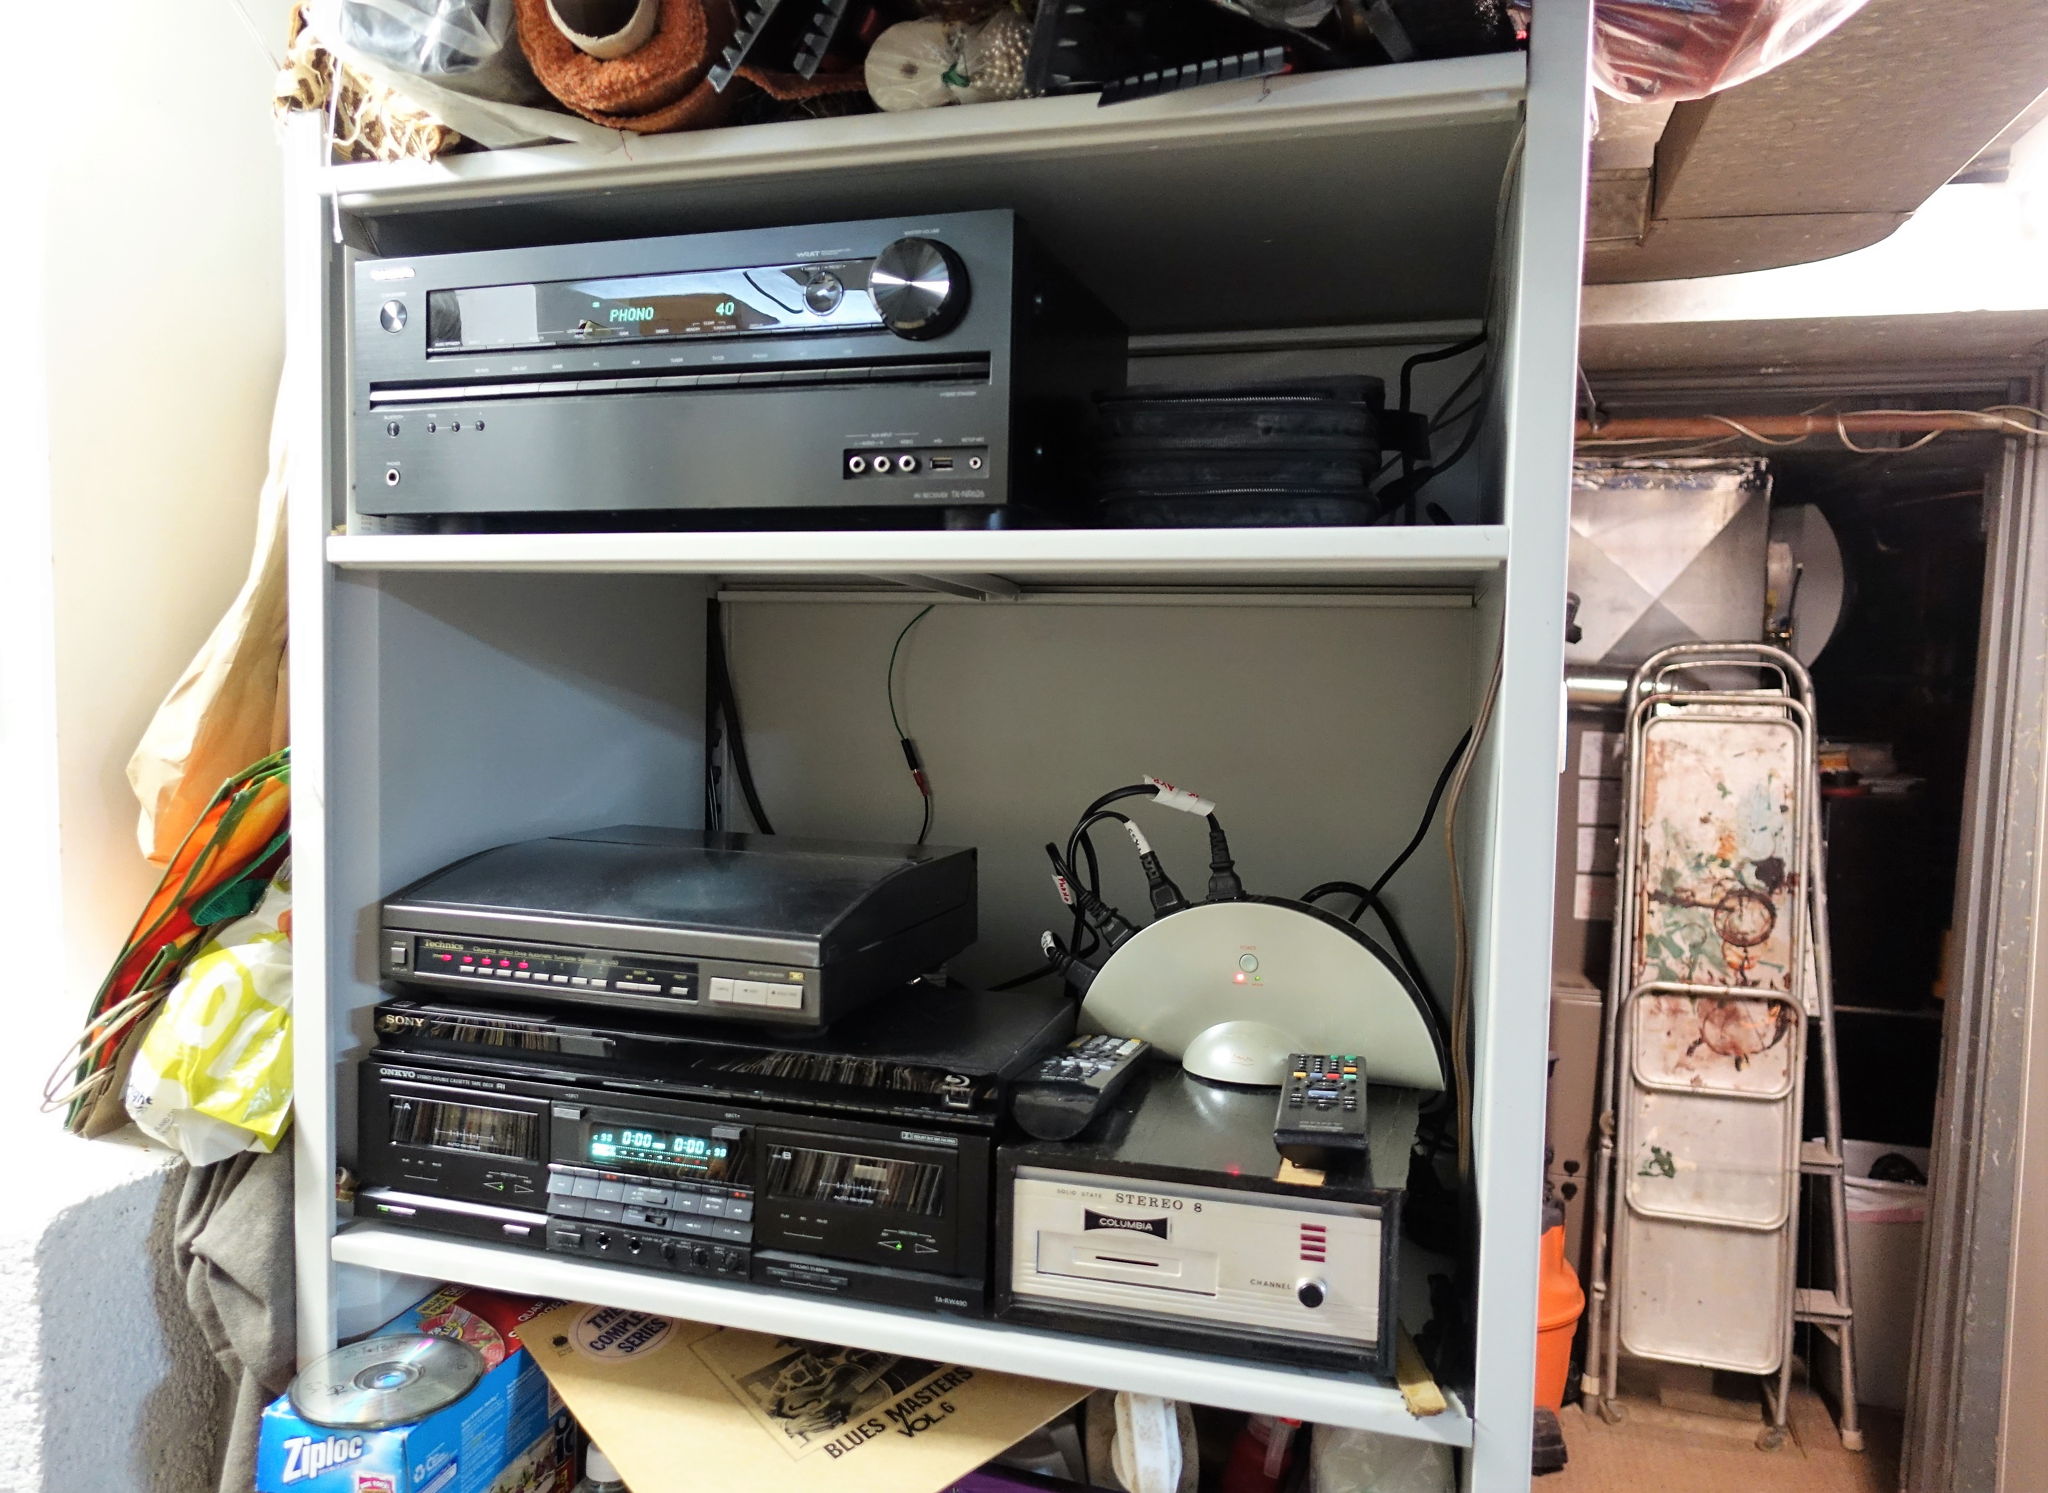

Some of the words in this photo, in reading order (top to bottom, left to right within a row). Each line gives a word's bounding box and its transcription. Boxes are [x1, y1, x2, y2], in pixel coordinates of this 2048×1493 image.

[609, 306, 654, 322] PHONO
[715, 302, 735, 316] 40
[424, 938, 465, 952] Technics
[386, 1014, 424, 1027] SONY
[380, 1067, 415, 1078] ONKYO
[622, 1130, 652, 1148] 0:00
[673, 1138, 705, 1155] 0:00
[1057, 1188, 1076, 1196] SOLID
[1081, 1191, 1102, 1199] STATE
[1115, 1192, 1183, 1211] STEREO
[1194, 1202, 1202, 1213] 8
[1099, 1217, 1153, 1231] COLUMBIA
[1250, 1279, 1292, 1290] CHANNEL
[517, 1301, 547, 1322] QUAR
[589, 1311, 646, 1351] COMPLE
[618, 1318, 668, 1353] SERIES
[824, 1418, 886, 1459] BLUES
[884, 1366, 974, 1423] MASTERS
[940, 1401, 956, 1415] 6
[282, 1435, 364, 1484] Ziploc
